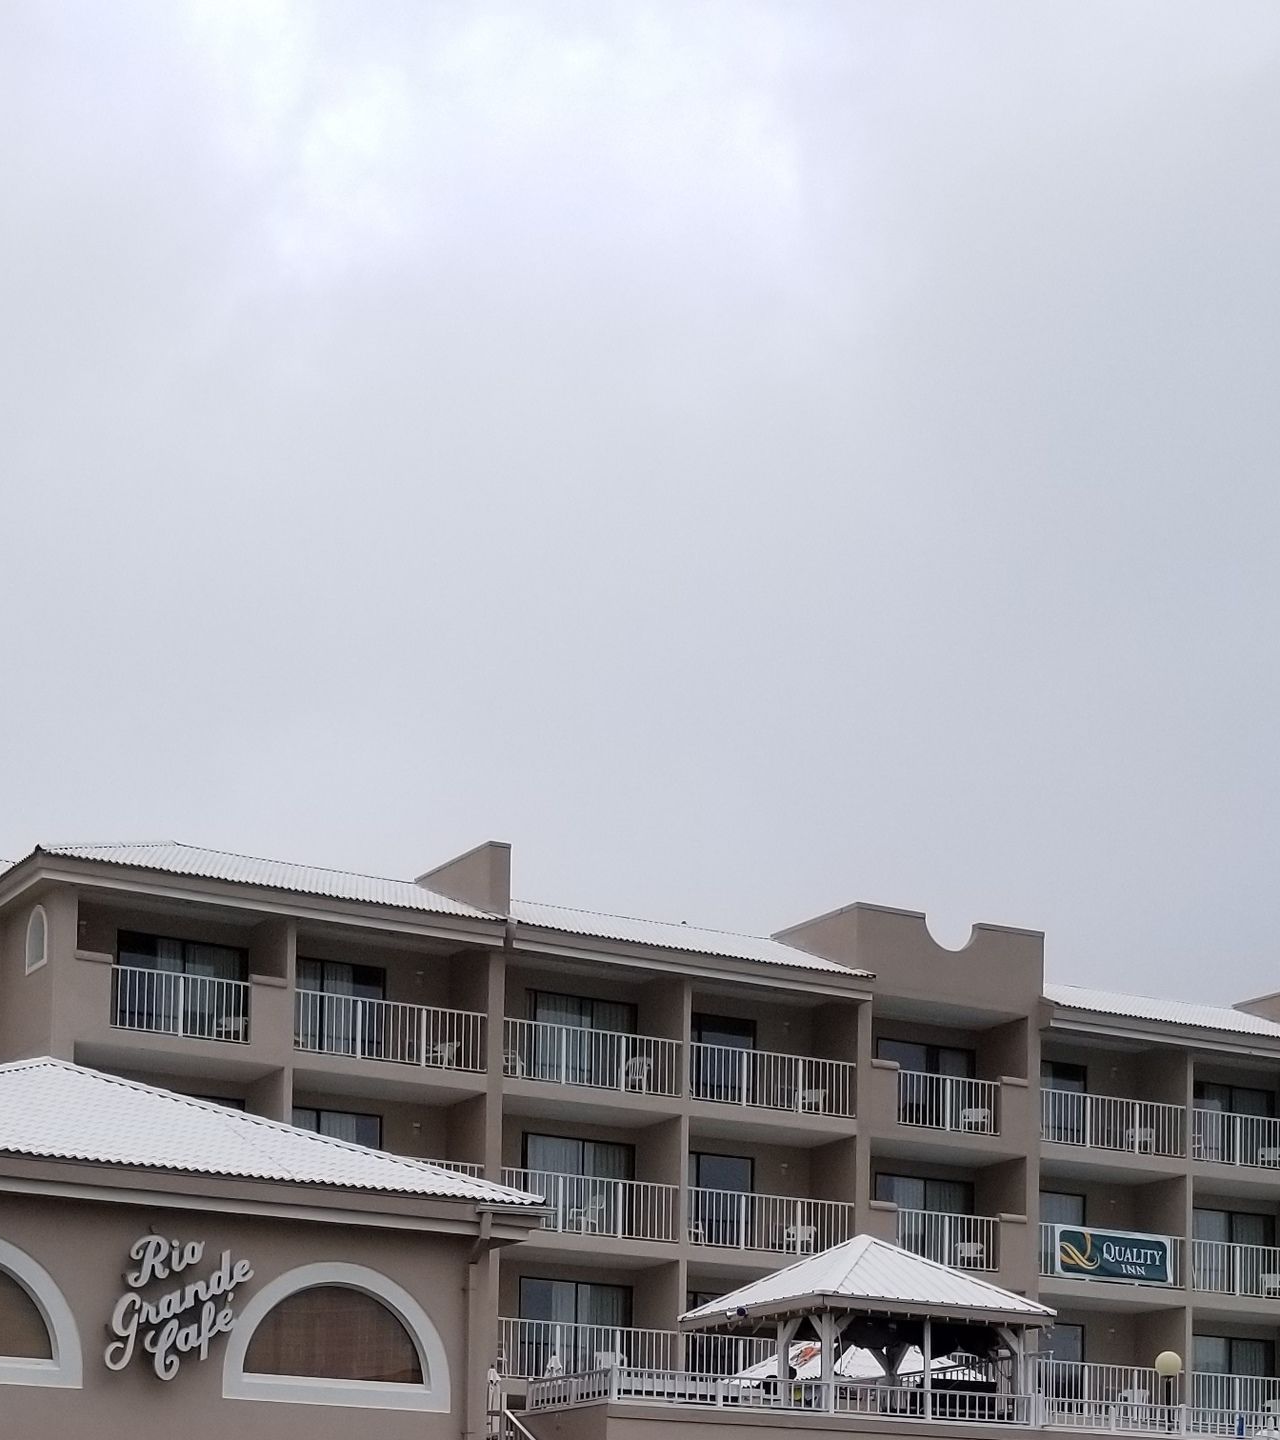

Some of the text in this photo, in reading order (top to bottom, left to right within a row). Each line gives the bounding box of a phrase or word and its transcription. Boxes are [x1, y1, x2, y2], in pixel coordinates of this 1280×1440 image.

[127, 1234, 206, 1288] Rio
[1103, 1241, 1163, 1266] QUALITY
[1121, 1264, 1146, 1276] INN
[104, 1249, 255, 1371] Grande
[144, 1292, 238, 1381] Café
